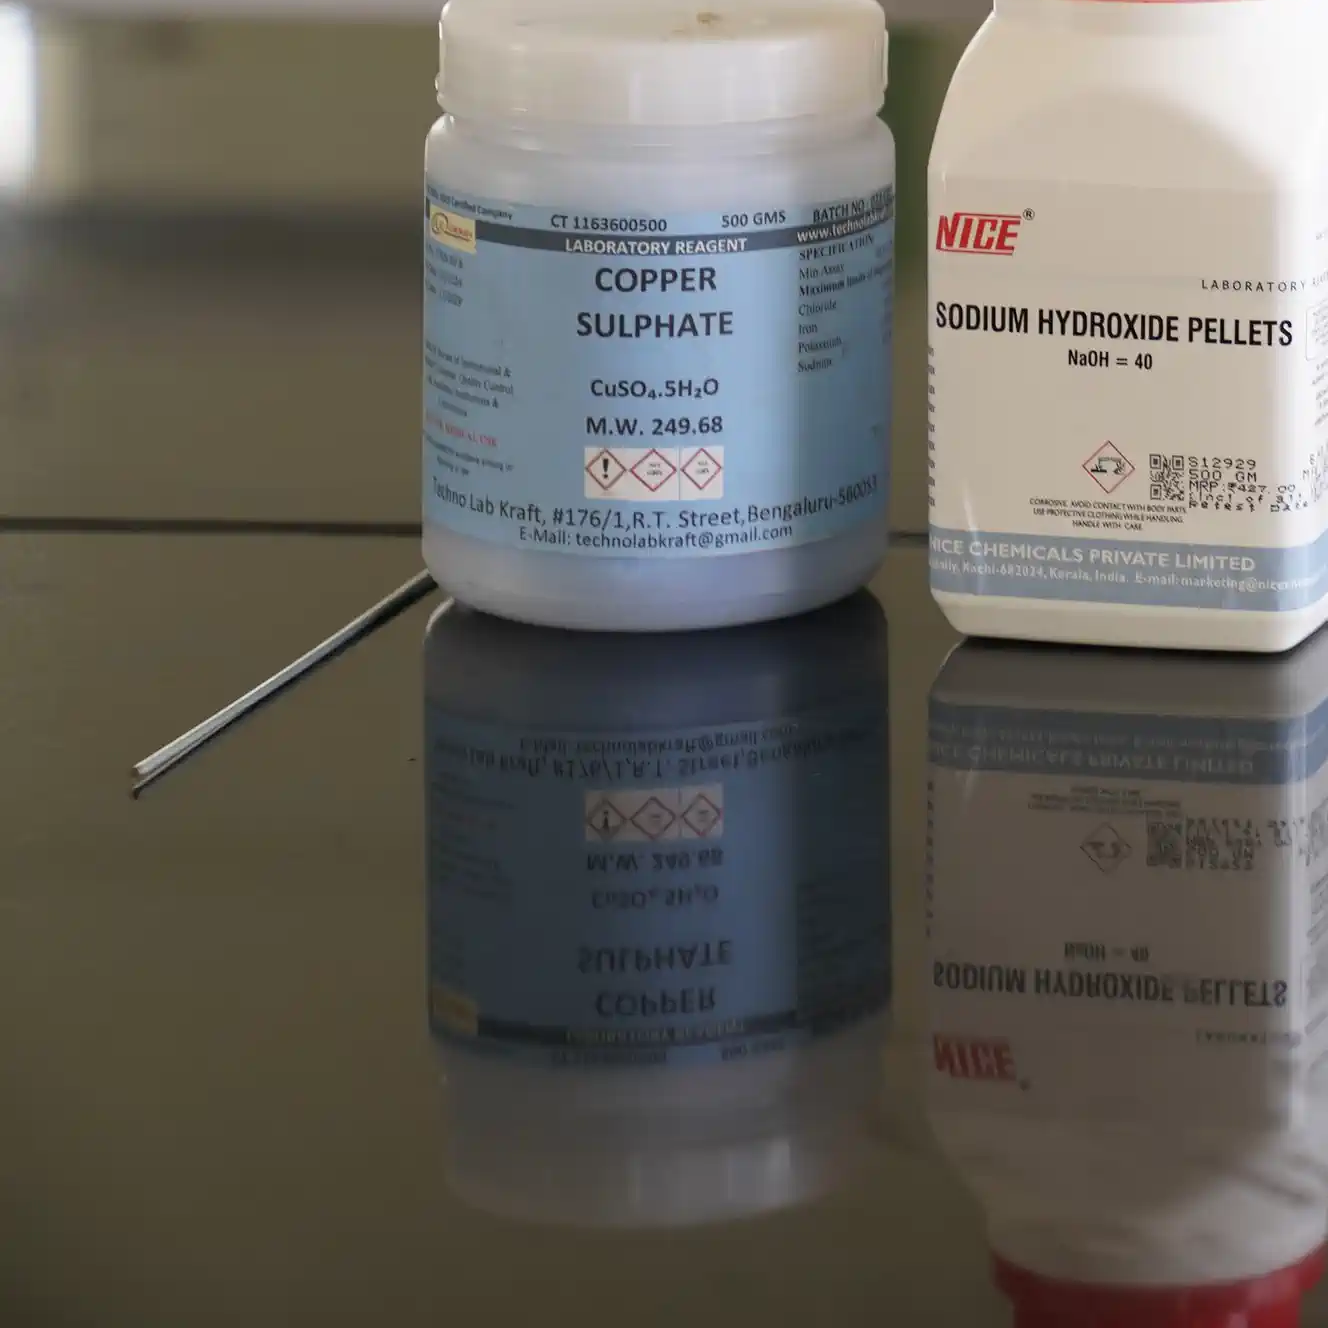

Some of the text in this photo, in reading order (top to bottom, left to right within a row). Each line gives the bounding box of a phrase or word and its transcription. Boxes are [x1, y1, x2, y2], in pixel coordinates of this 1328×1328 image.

[550, 214, 668, 232] CT 1163600500
[721, 209, 786, 228] 500 GMS
[812, 202, 849, 224] BATCH
[936, 212, 1021, 256] NICE
[565, 237, 748, 255] LABORATORY REAGENT
[595, 266, 717, 293] COPPER
[1201, 278, 1307, 293] LABORATORY
[576, 310, 734, 339] SULPHATE
[936, 300, 1029, 334] SODIUM
[1037, 308, 1180, 342] HYDROXIDE
[1187, 317, 1293, 347] PELLETS
[1068, 349, 1110, 367] NaOH
[1134, 353, 1153, 370] 40
[585, 415, 723, 436] M.W. 249.68
[1188, 468, 1257, 483] 500 GM
[1189, 480, 1219, 493] MRP
[432, 475, 466, 508] Techno
[470, 496, 494, 516] Lab
[499, 499, 546, 526] Kraft,
[519, 524, 793, 549] E-Mail: technolabkraft@gmail.com
[968, 540, 1084, 563] CHEMICALS
[1088, 548, 1171, 568] PRIVATE
[1175, 553, 1256, 572] LIMITED
